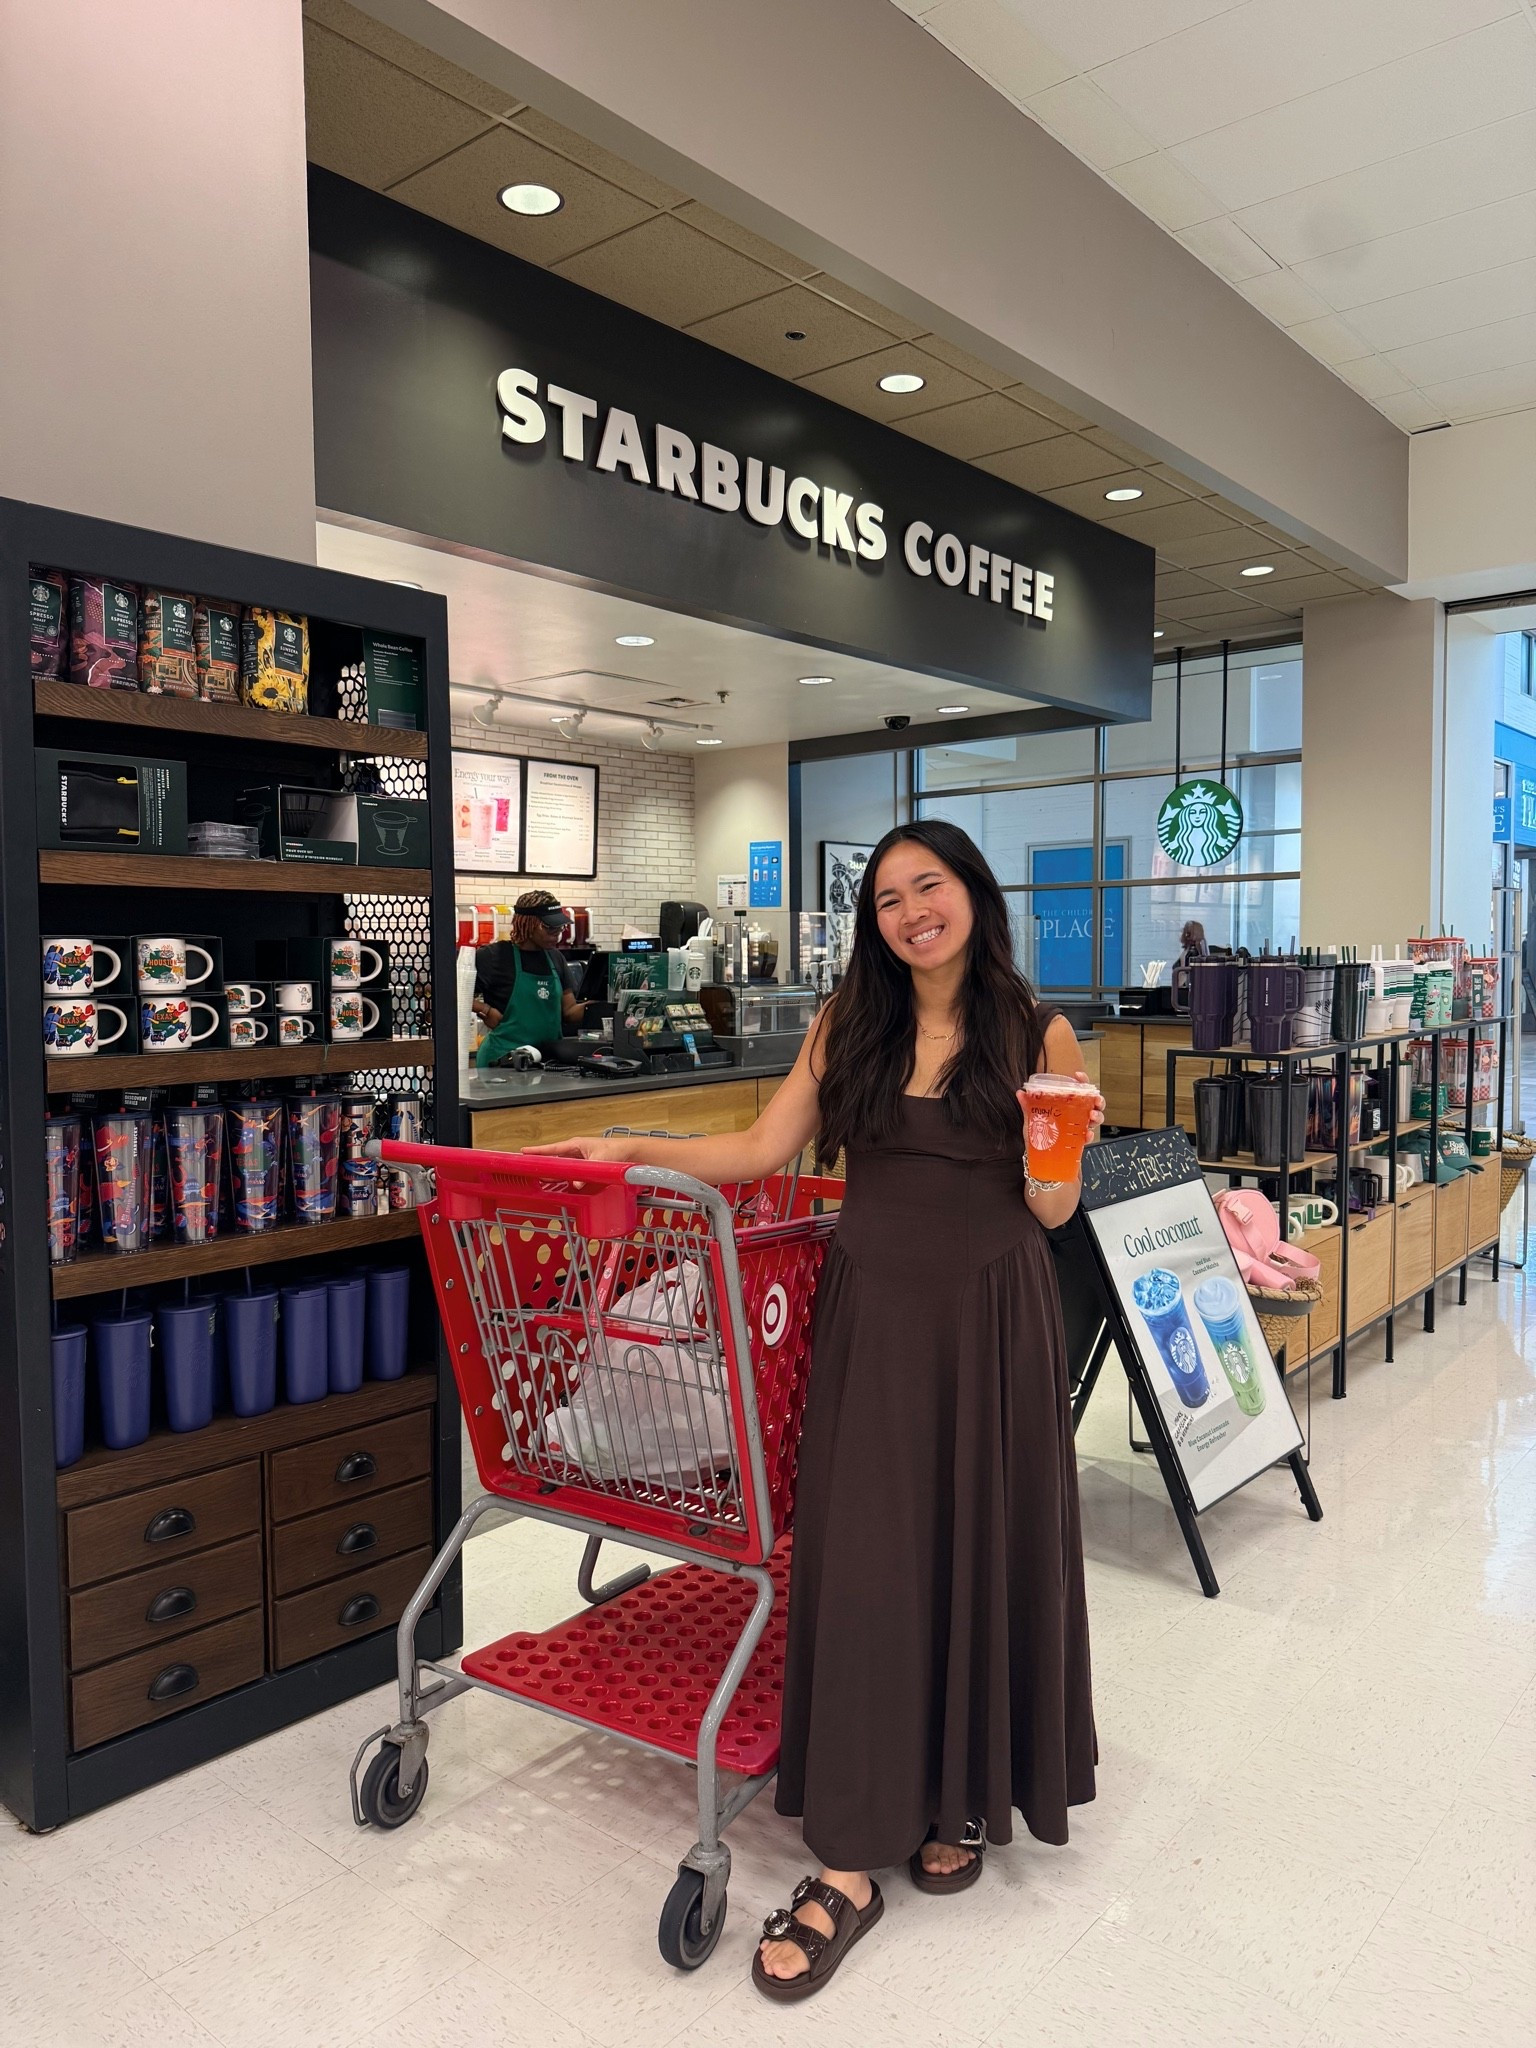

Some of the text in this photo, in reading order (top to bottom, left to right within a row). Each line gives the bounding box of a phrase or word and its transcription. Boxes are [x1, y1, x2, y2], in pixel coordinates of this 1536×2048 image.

[497, 367, 1055, 622] STARBUCKS COFFEE
[29, 610, 54, 620] SPRESSO
[110, 616, 134, 626] ESPRESSO
[454, 767, 512, 785] Energy your way
[1042, 918, 1116, 939] PLACE
[60, 956, 81, 964] TEXAS
[149, 958, 177, 966] HOUSTON
[59, 1016, 80, 1025] TEXAS
[153, 1013, 174, 1021] TEXAS
[1031, 1107, 1053, 1118] enjoy!
[1124, 1215, 1203, 1258] Cool coconut
[1192, 1261, 1219, 1276] Coconut Matcha
[1187, 1420, 1230, 1448] Blue Coconut Lemonade
[1197, 1431, 1227, 1452] Energy Refresher
